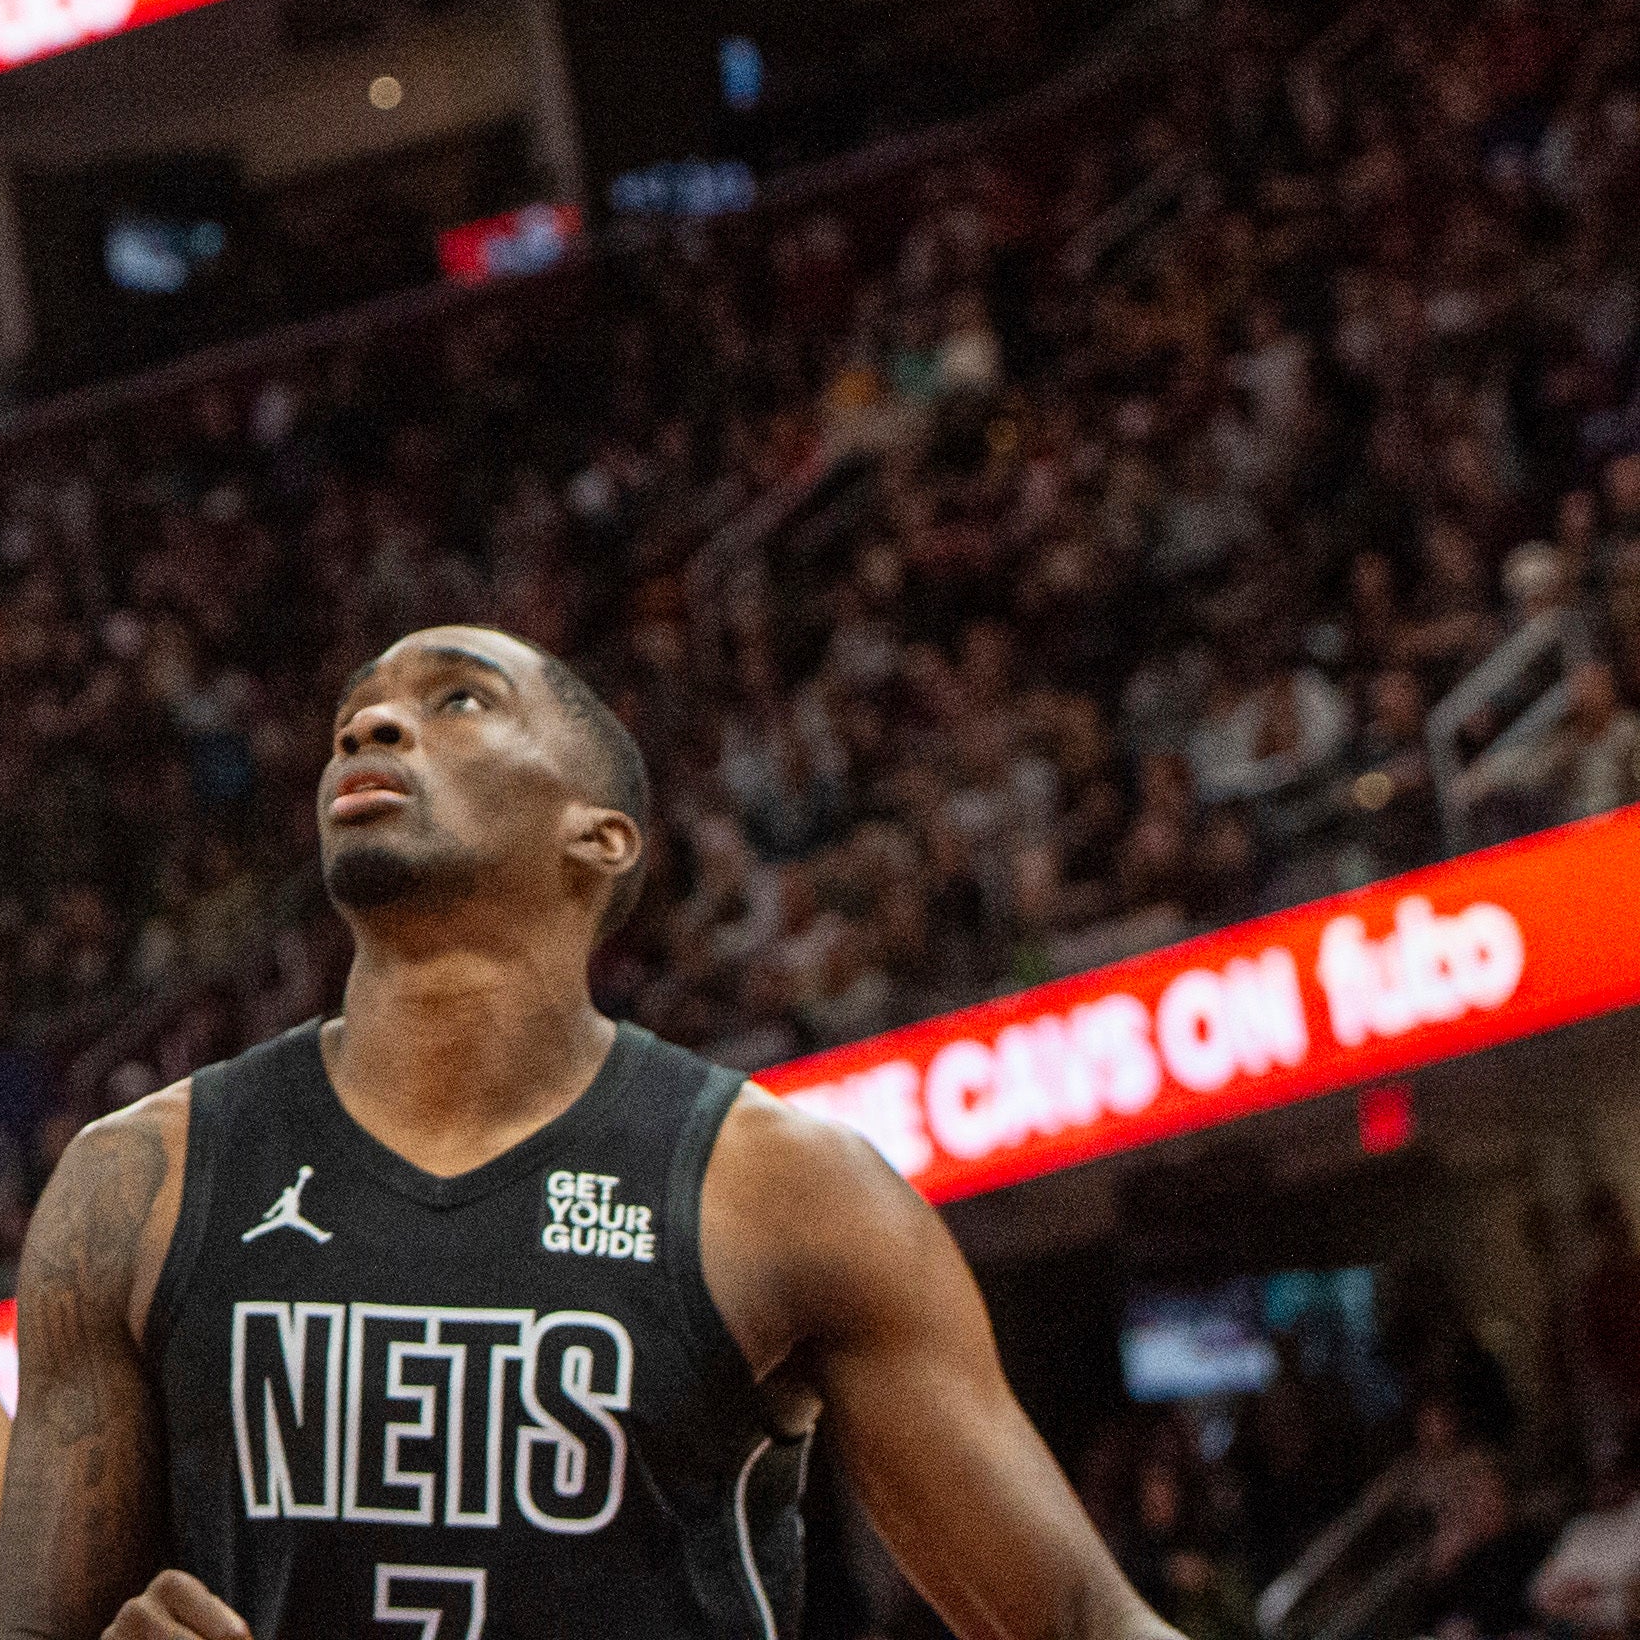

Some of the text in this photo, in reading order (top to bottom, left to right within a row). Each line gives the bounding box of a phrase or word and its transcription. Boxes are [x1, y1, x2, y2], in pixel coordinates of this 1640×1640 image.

[926, 992, 1161, 1161] CAVS
[1157, 946, 1309, 1093] ON
[1317, 894, 1526, 1048] fubo
[547, 1170, 621, 1203] GET
[548, 1198, 653, 1233] YOUR
[542, 1224, 655, 1263] GUIDE
[231, 1300, 634, 1536] NETS
